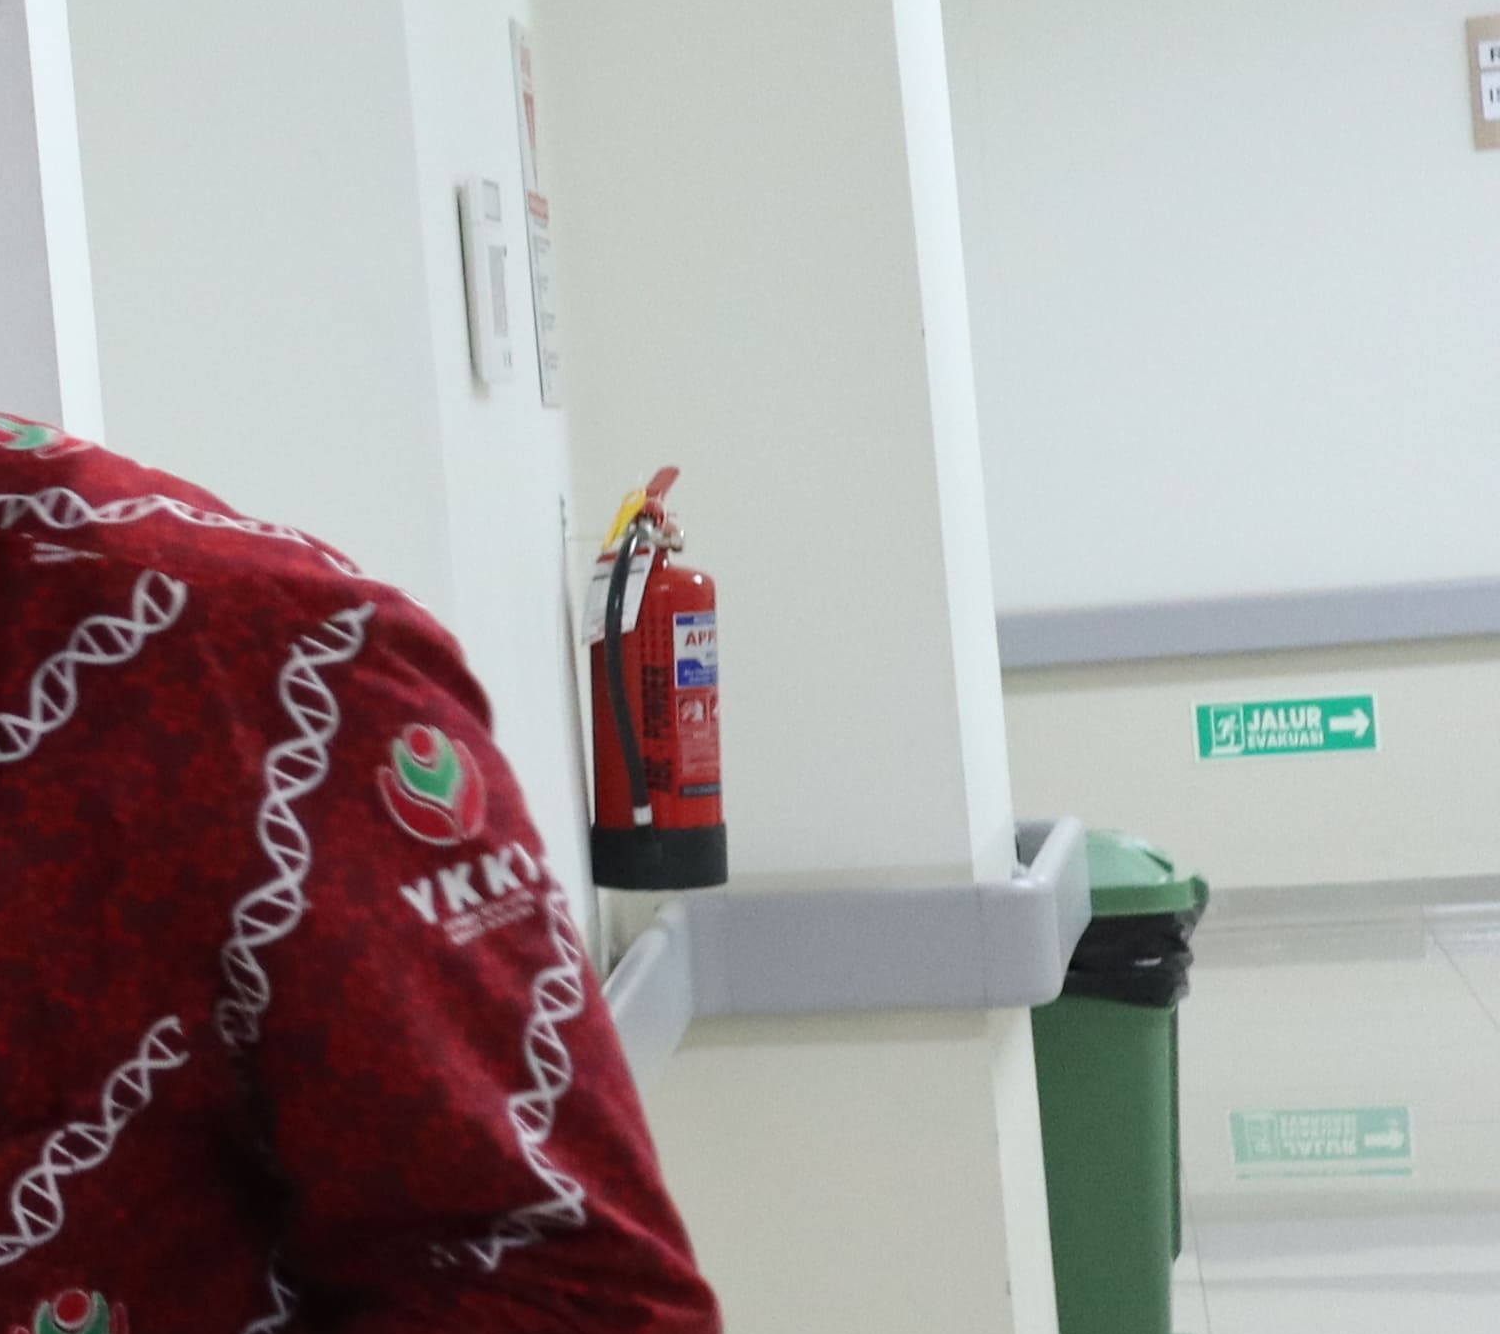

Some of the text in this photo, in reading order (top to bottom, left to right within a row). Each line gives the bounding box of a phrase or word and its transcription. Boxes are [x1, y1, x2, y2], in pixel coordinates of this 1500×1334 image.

[1247, 706, 1322, 732] JALUR
[1247, 730, 1325, 750] EVAKUASI
[399, 841, 540, 925] YKKI
